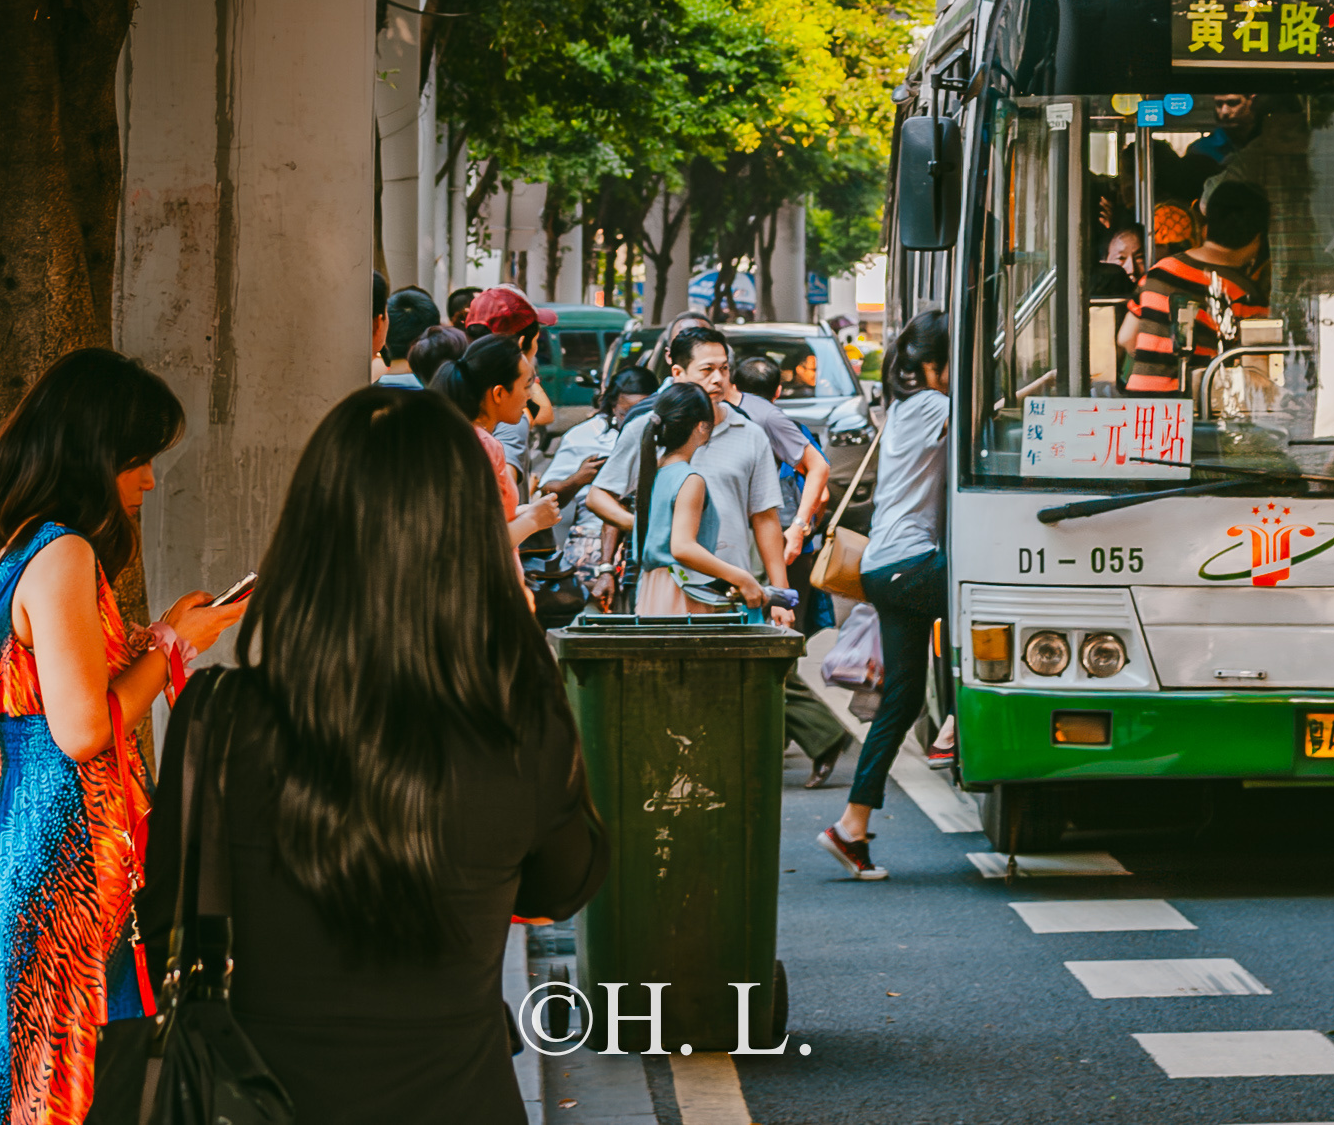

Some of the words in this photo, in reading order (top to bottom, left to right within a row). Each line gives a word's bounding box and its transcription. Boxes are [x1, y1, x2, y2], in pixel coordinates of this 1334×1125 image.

[1187, 0, 1321, 54] 黄石路
[1071, 403, 1186, 468] 三元里站
